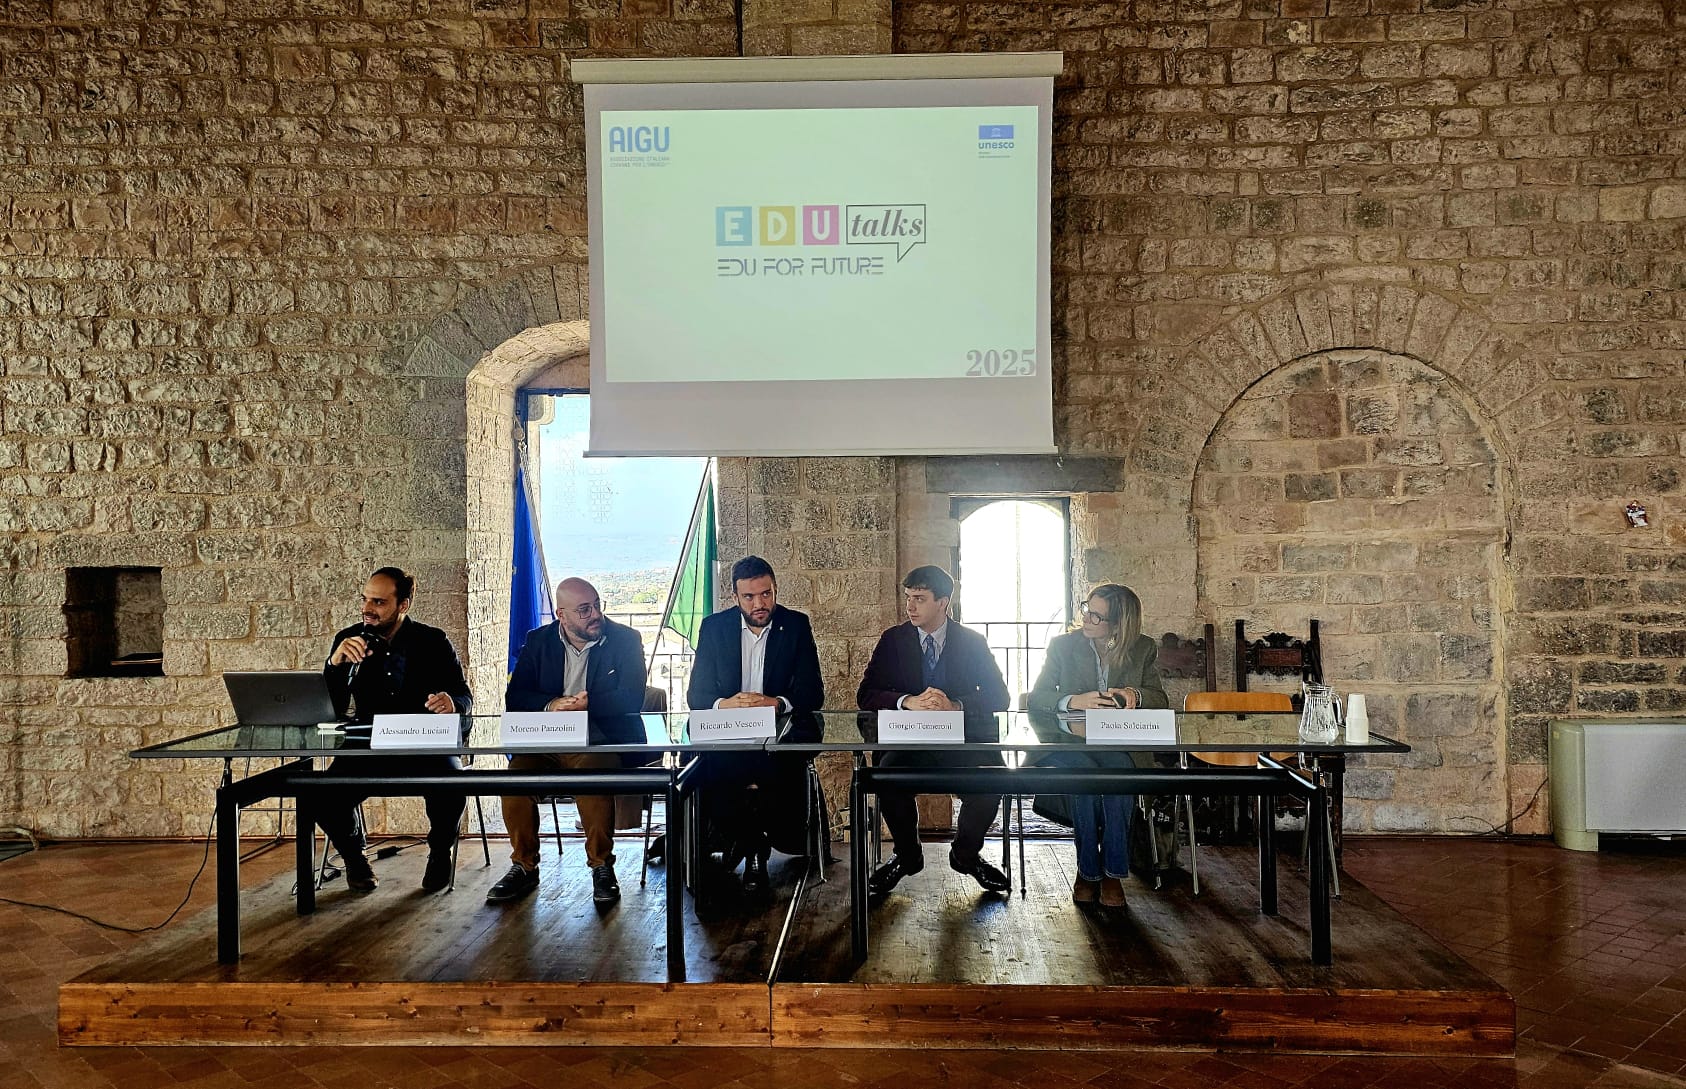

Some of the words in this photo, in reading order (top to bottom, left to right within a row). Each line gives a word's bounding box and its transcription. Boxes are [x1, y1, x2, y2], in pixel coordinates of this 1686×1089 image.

[609, 126, 670, 152] AIGU
[978, 141, 1015, 150] unesco
[851, 209, 923, 237] talks
[718, 258, 757, 277] EDU
[763, 257, 804, 277] FOR
[811, 257, 884, 276] FUTURE
[966, 349, 1036, 376] 2025
[378, 727, 420, 735] Alessandro
[422, 726, 450, 735] Luciani
[510, 725, 539, 733] Moreno
[541, 723, 576, 733] Panzolini
[700, 721, 733, 731] Riccardo
[735, 720, 764, 728] Vescovi
[1101, 721, 1122, 729] Paola
